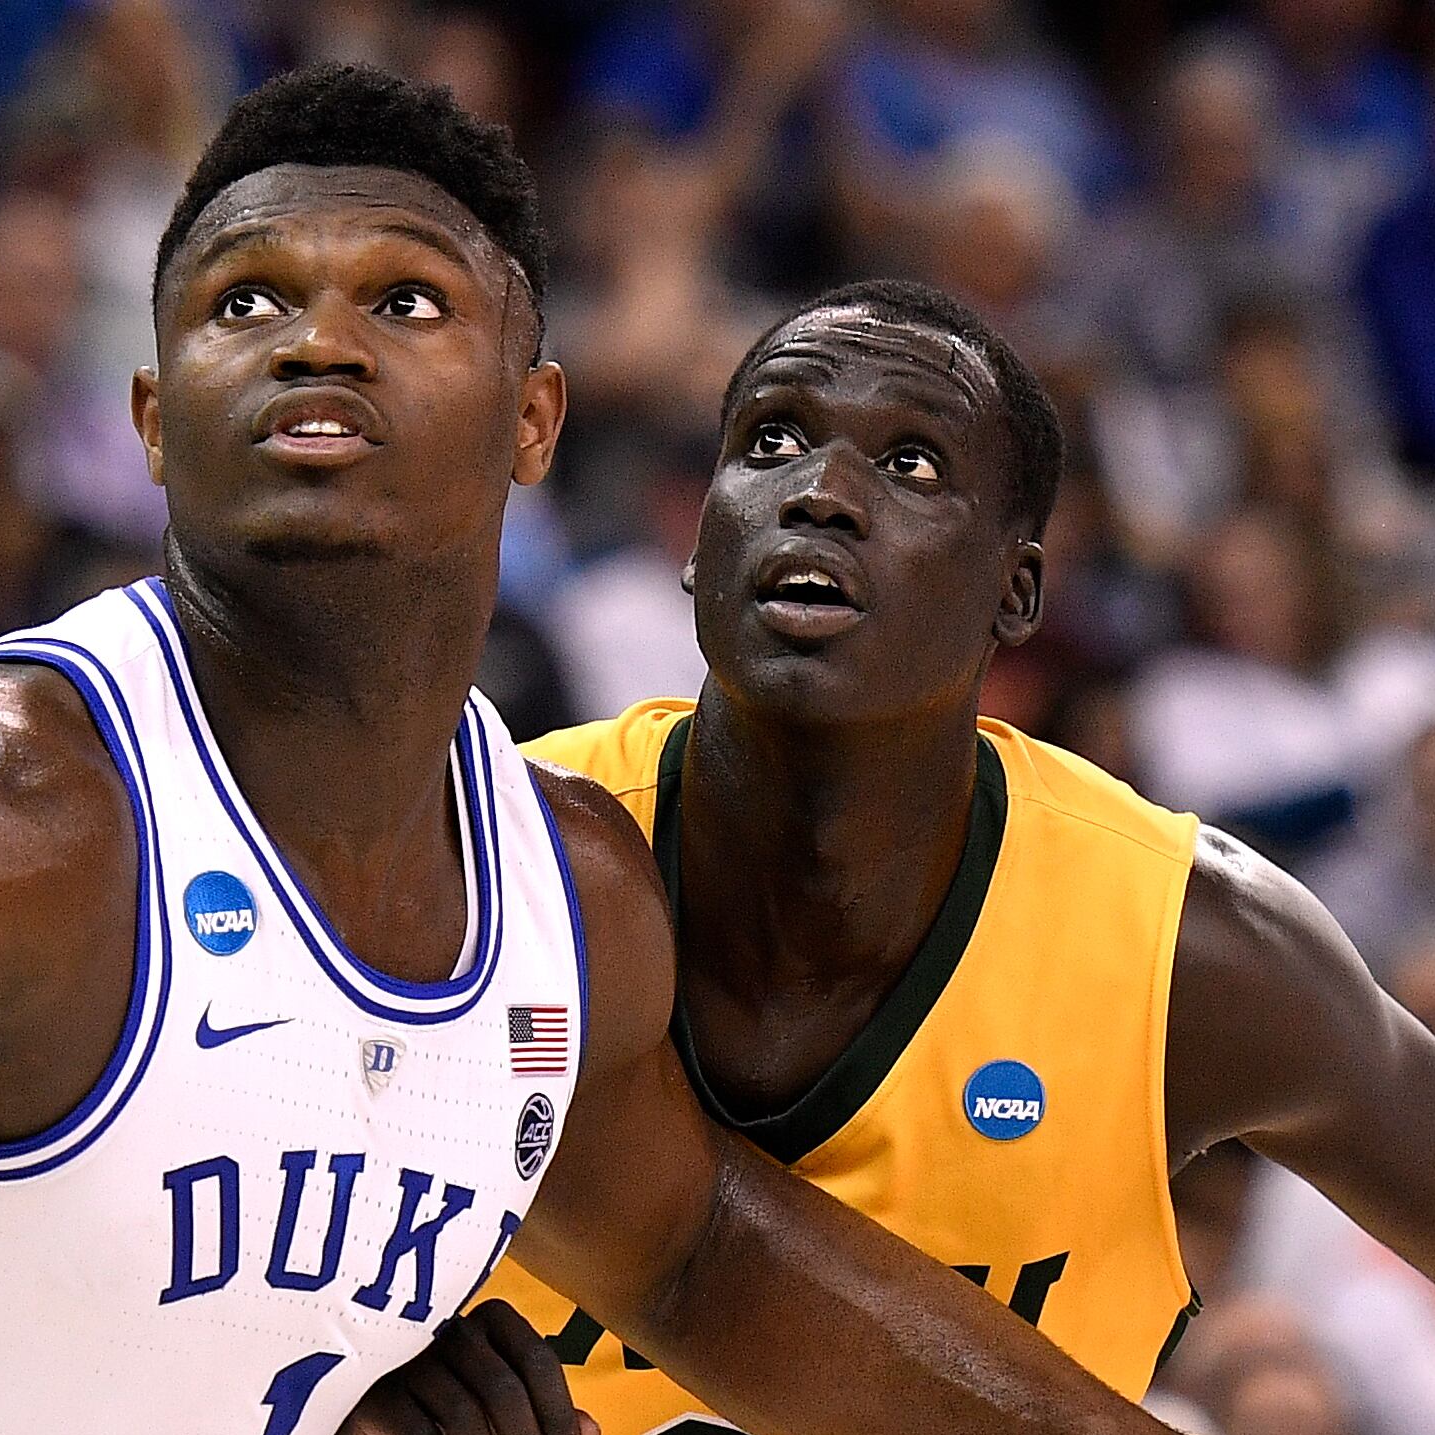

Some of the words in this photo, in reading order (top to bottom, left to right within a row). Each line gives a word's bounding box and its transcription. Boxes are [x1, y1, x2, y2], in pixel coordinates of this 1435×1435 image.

[195, 909, 254, 934] NCAA
[368, 1044, 395, 1072] D
[973, 1096, 1040, 1121] NCAA
[521, 1121, 552, 1142] ACC
